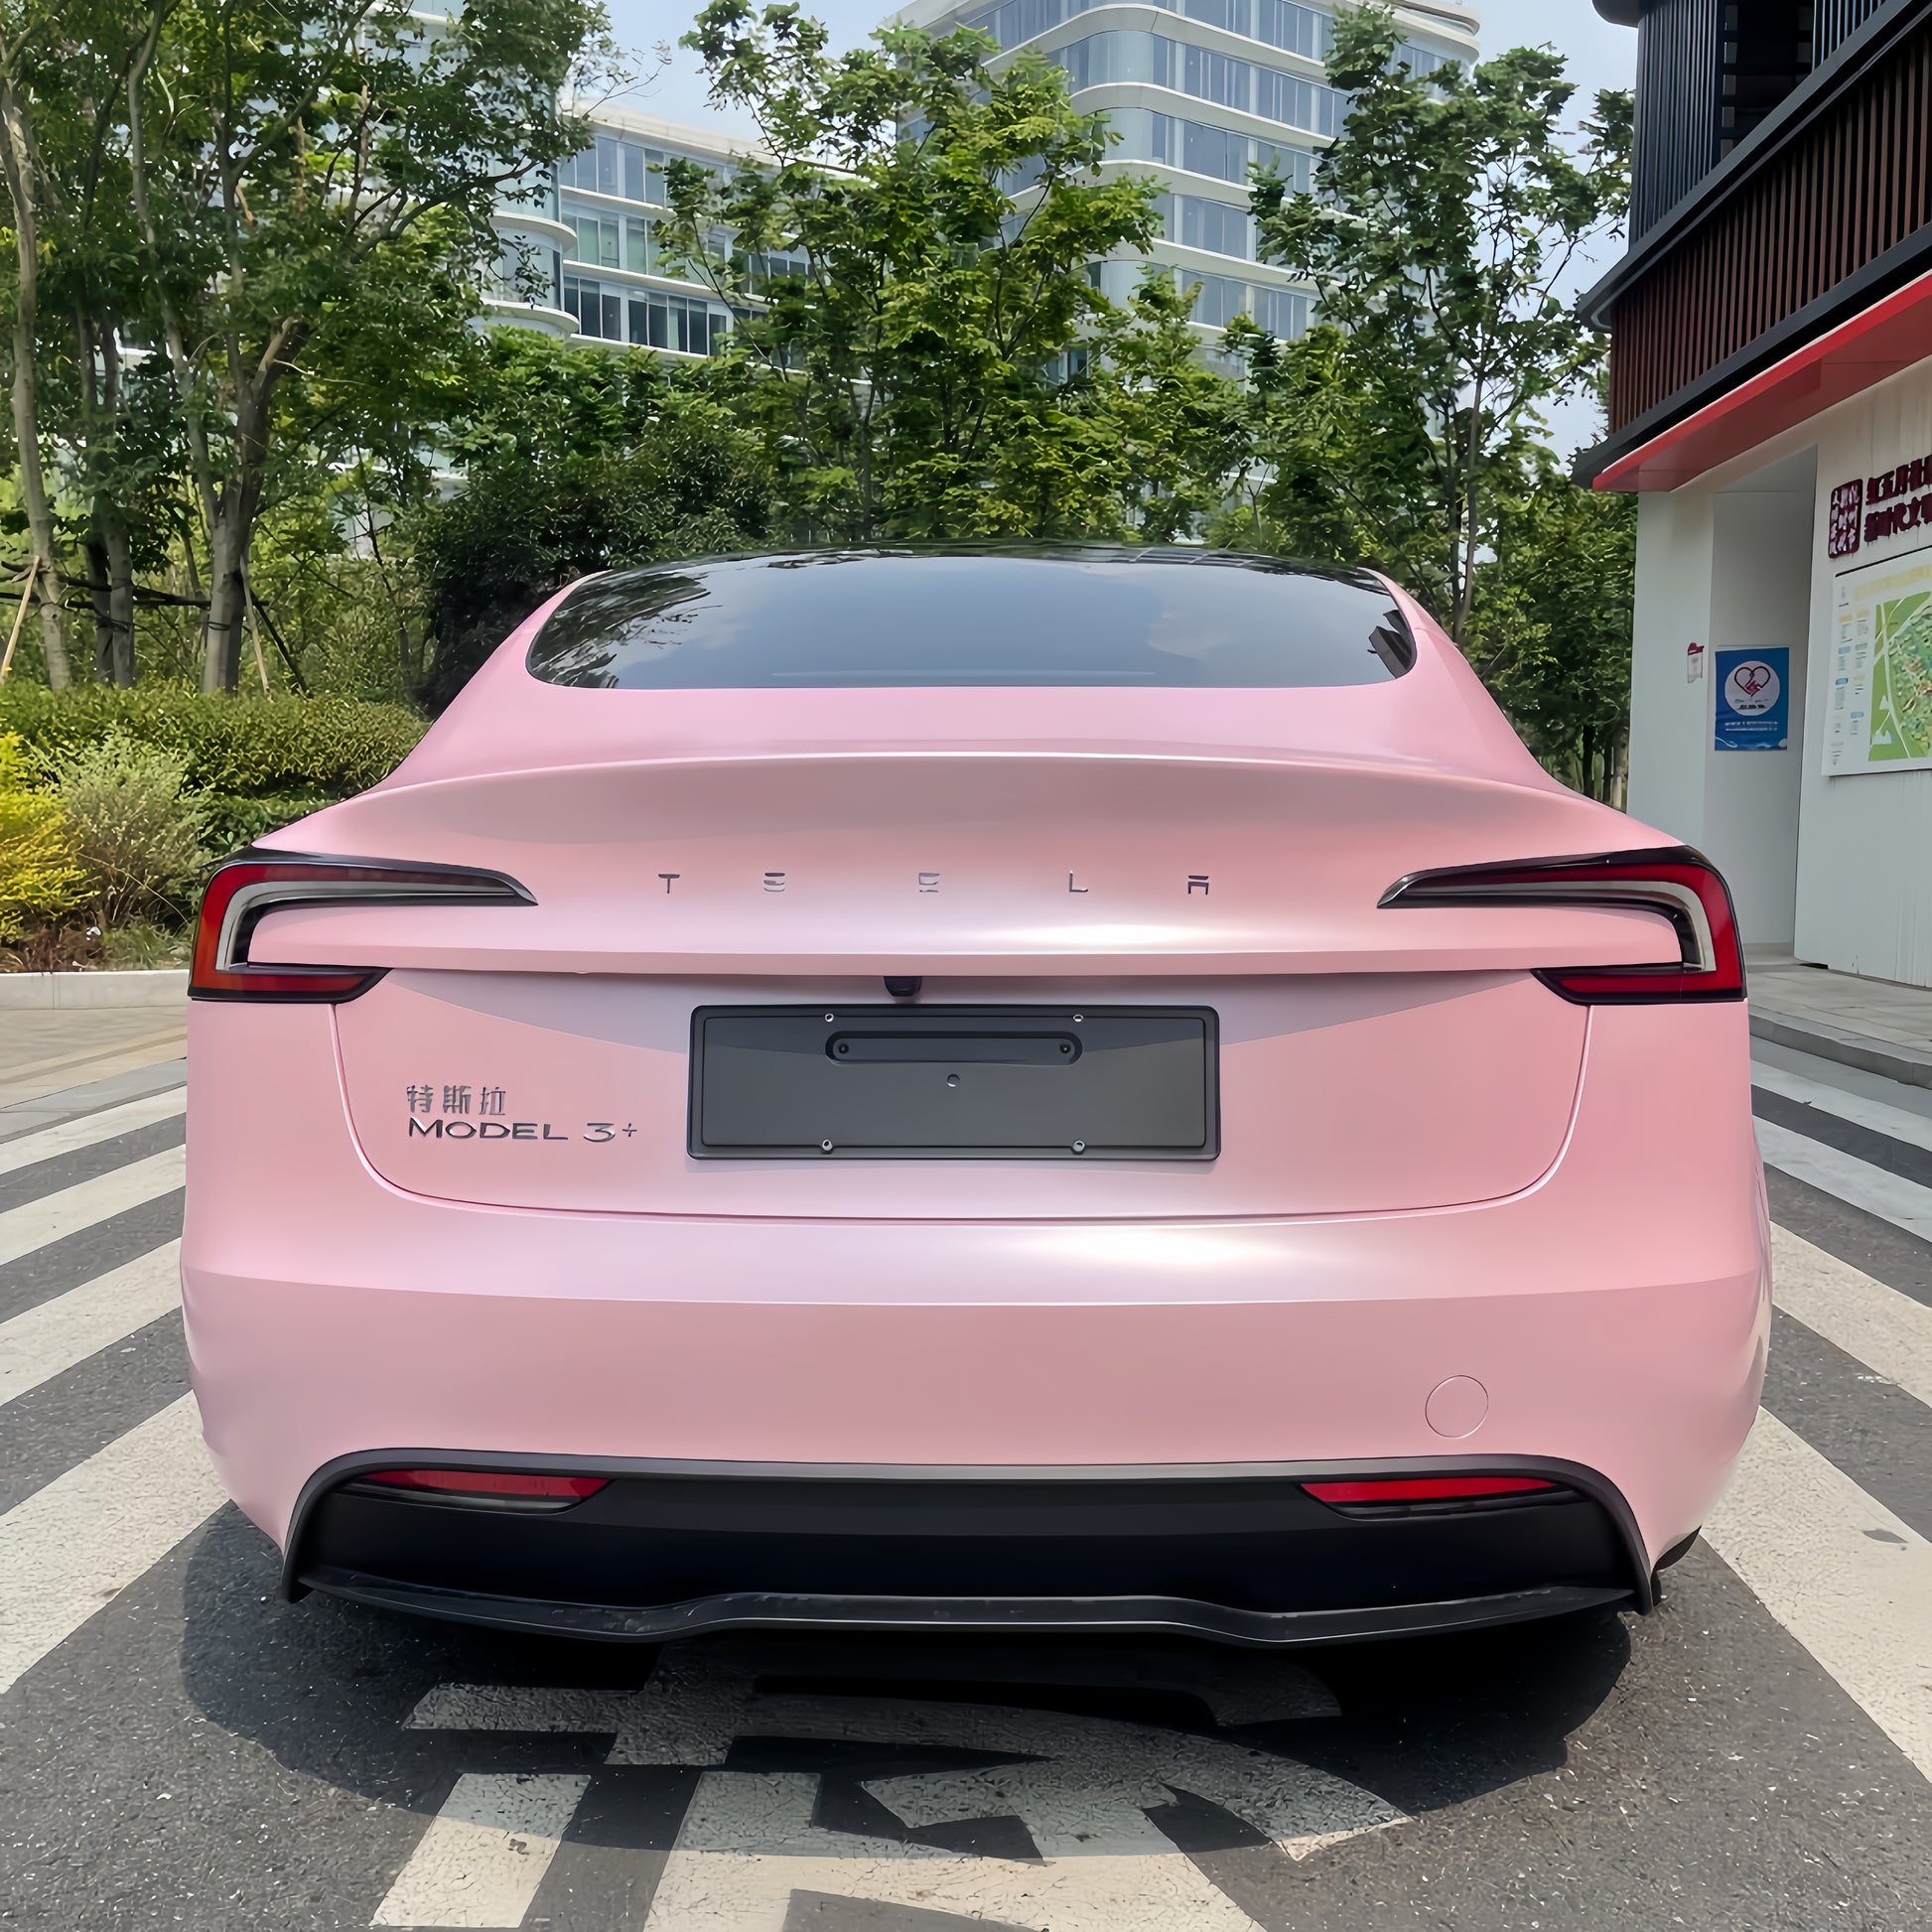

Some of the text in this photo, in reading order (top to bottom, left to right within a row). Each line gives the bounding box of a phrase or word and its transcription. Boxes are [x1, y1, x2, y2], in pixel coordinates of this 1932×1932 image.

[658, 871, 1209, 896] TESLA
[406, 1084, 506, 1115] 特斯拉
[409, 1117, 569, 1140] MODEL
